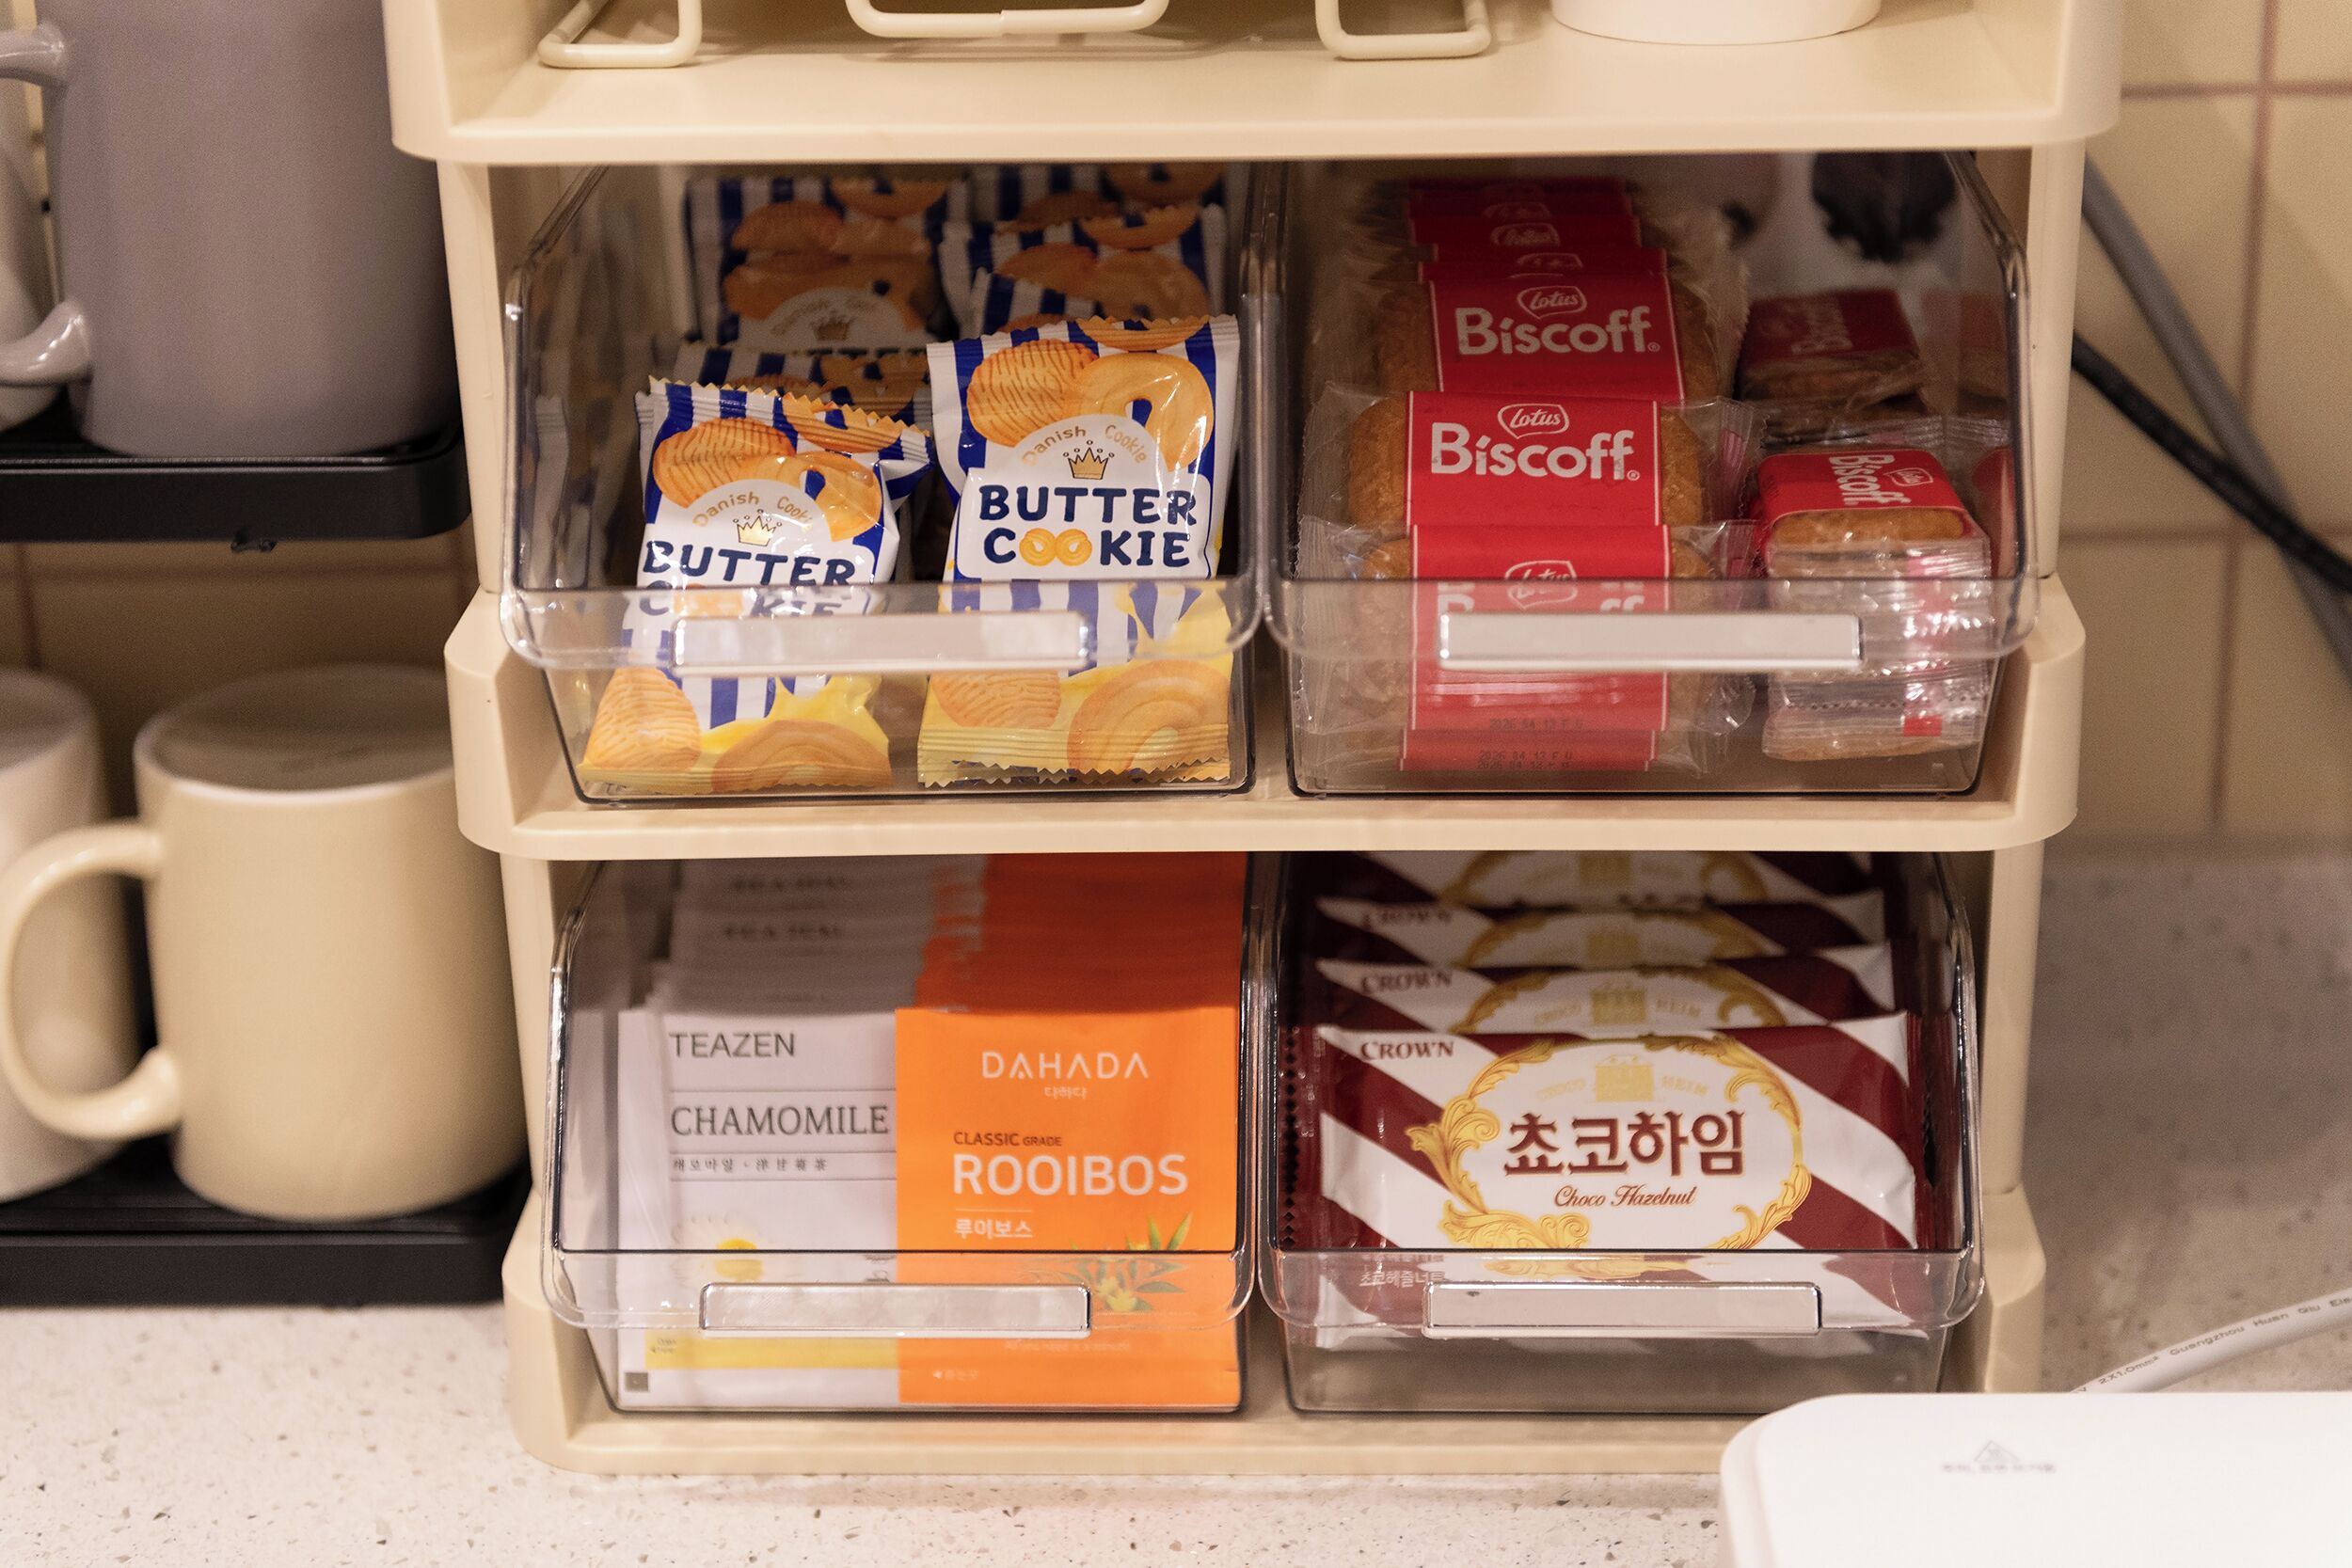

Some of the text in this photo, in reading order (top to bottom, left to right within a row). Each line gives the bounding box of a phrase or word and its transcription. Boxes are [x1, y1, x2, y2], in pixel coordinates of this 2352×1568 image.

[1530, 291, 1578, 310] Lotus
[1510, 408, 1561, 429] Lotus
[1022, 424, 1148, 467] Danish Cookie
[692, 491, 760, 527] Danish
[979, 484, 1197, 525] BUTTER
[643, 540, 856, 586] BUTTER
[1361, 972, 1452, 993] CROWN
[669, 1033, 795, 1057] TEAZEN
[1360, 1041, 1454, 1060] CROWN
[981, 1052, 1149, 1079] DAHADA
[1044, 1086, 1088, 1099] 다하다
[671, 1105, 889, 1136] CHAMOMILE
[953, 1132, 1062, 1147] CLASSIC GRADE
[1503, 1110, 1744, 1176] 초코하임
[953, 1153, 1188, 1196] ROOIBOS
[1554, 1182, 1696, 1207] Choco Hazelnut
[954, 1218, 1033, 1239] 루이보스
[2169, 1326, 2245, 1355] Guangzhou
